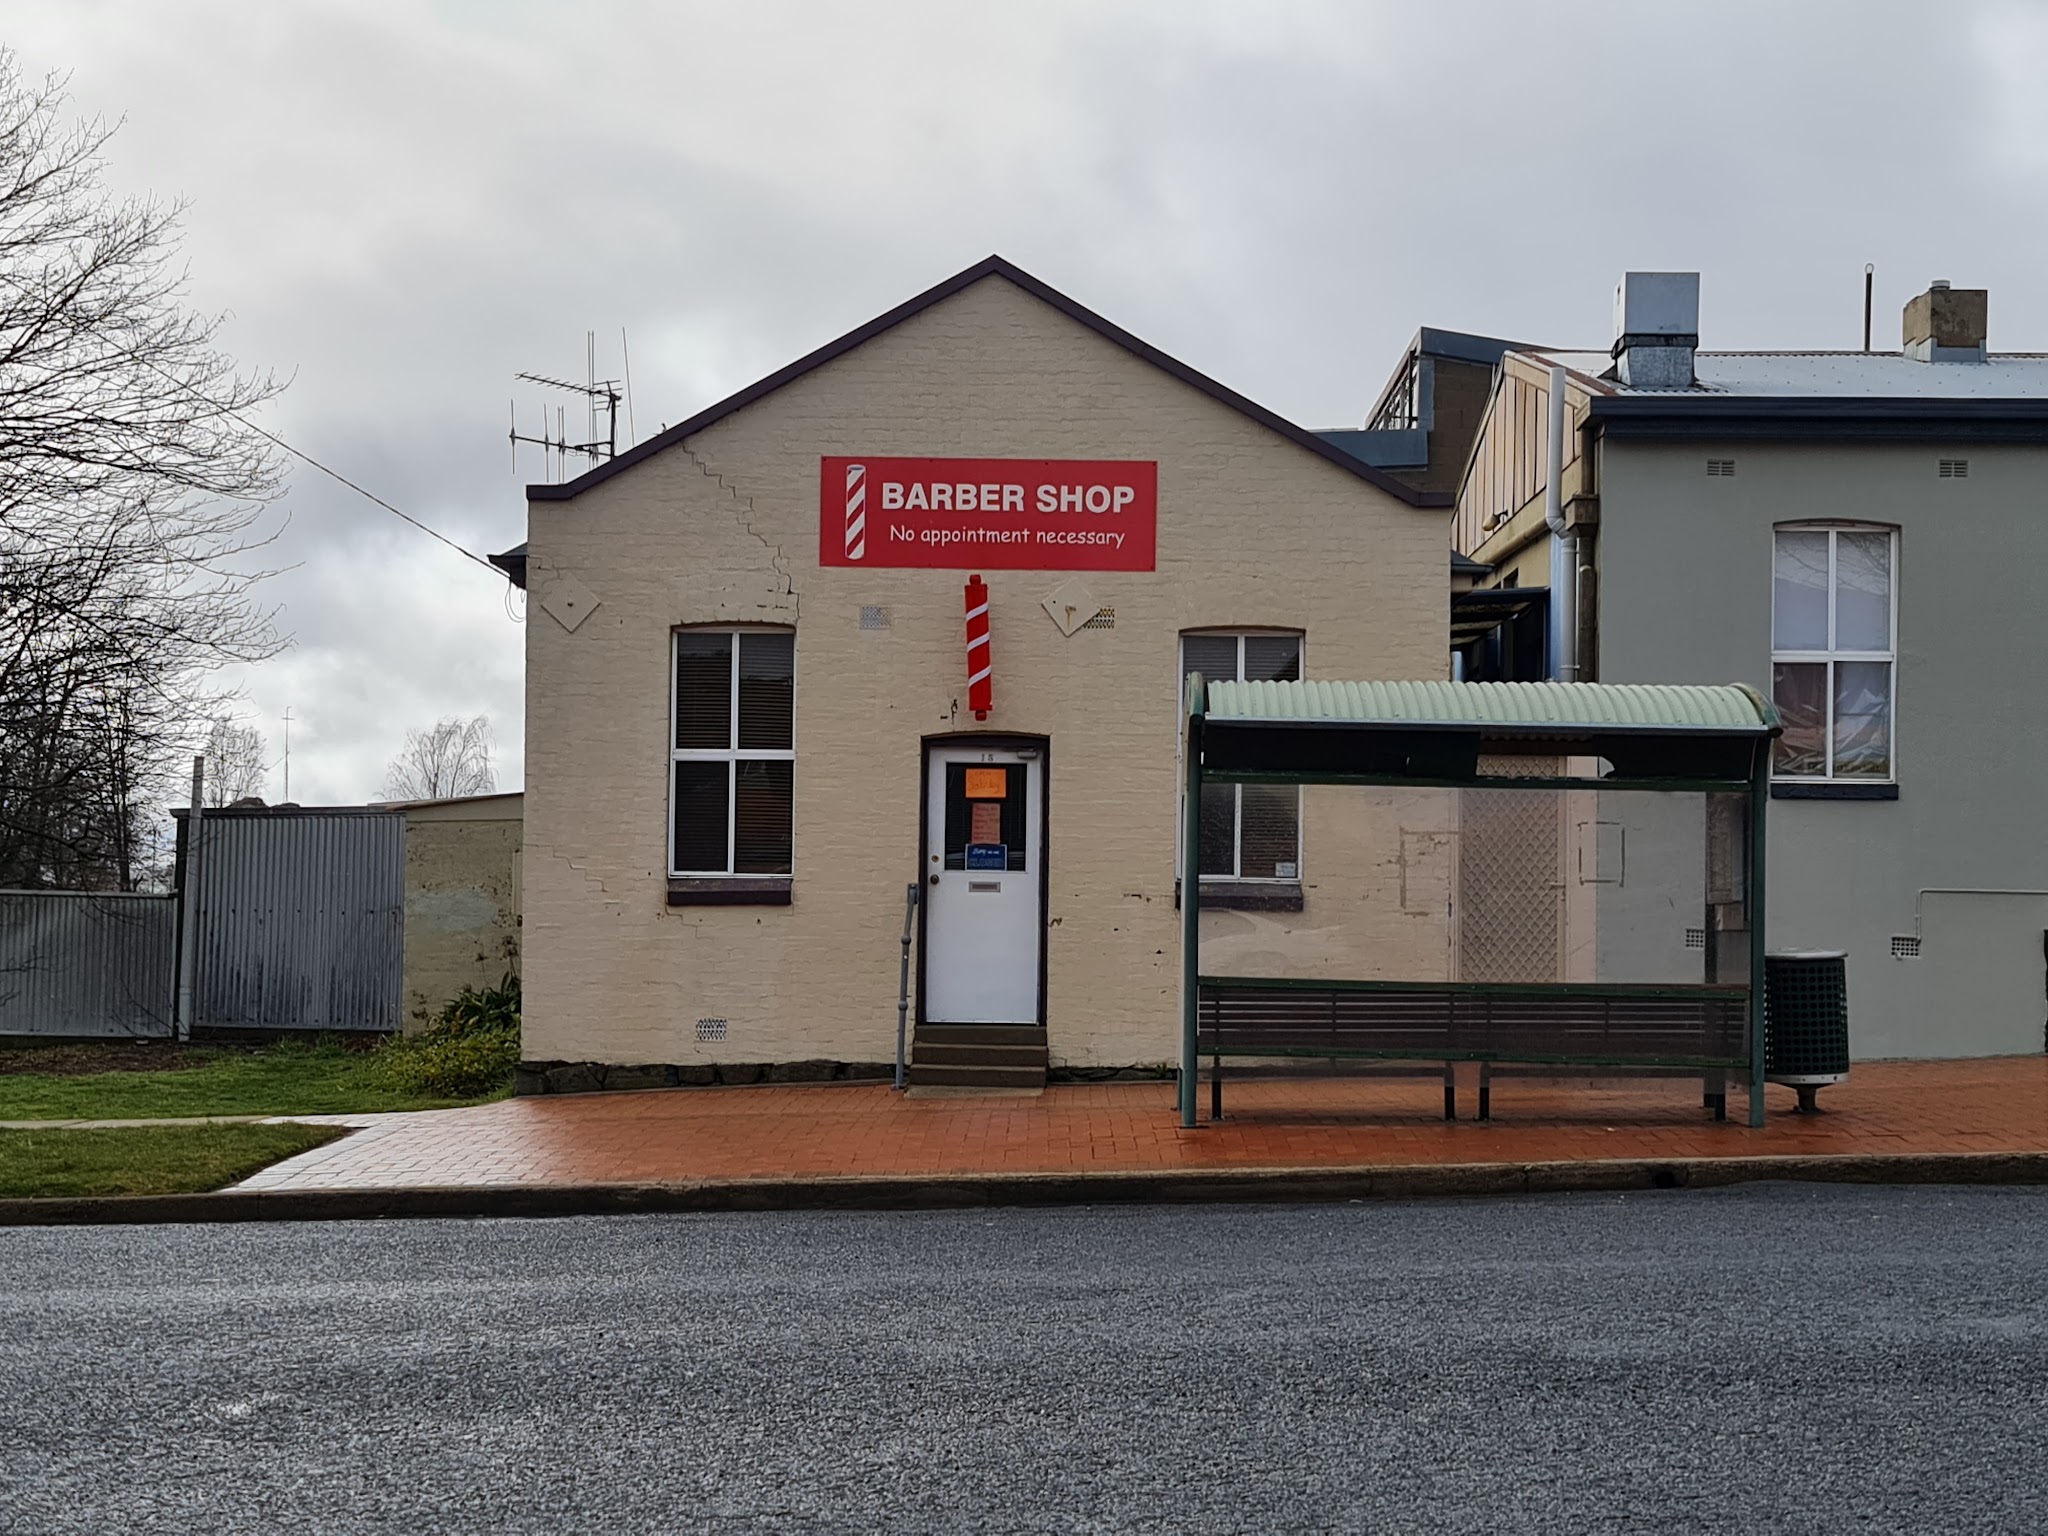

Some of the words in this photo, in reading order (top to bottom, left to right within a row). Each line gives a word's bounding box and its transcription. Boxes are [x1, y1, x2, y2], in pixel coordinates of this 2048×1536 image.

[882, 482, 1025, 512] BARBER
[1036, 484, 1135, 513] SHOP
[890, 525, 915, 542] No
[920, 526, 1031, 546] appointment
[1036, 529, 1125, 549] necessary
